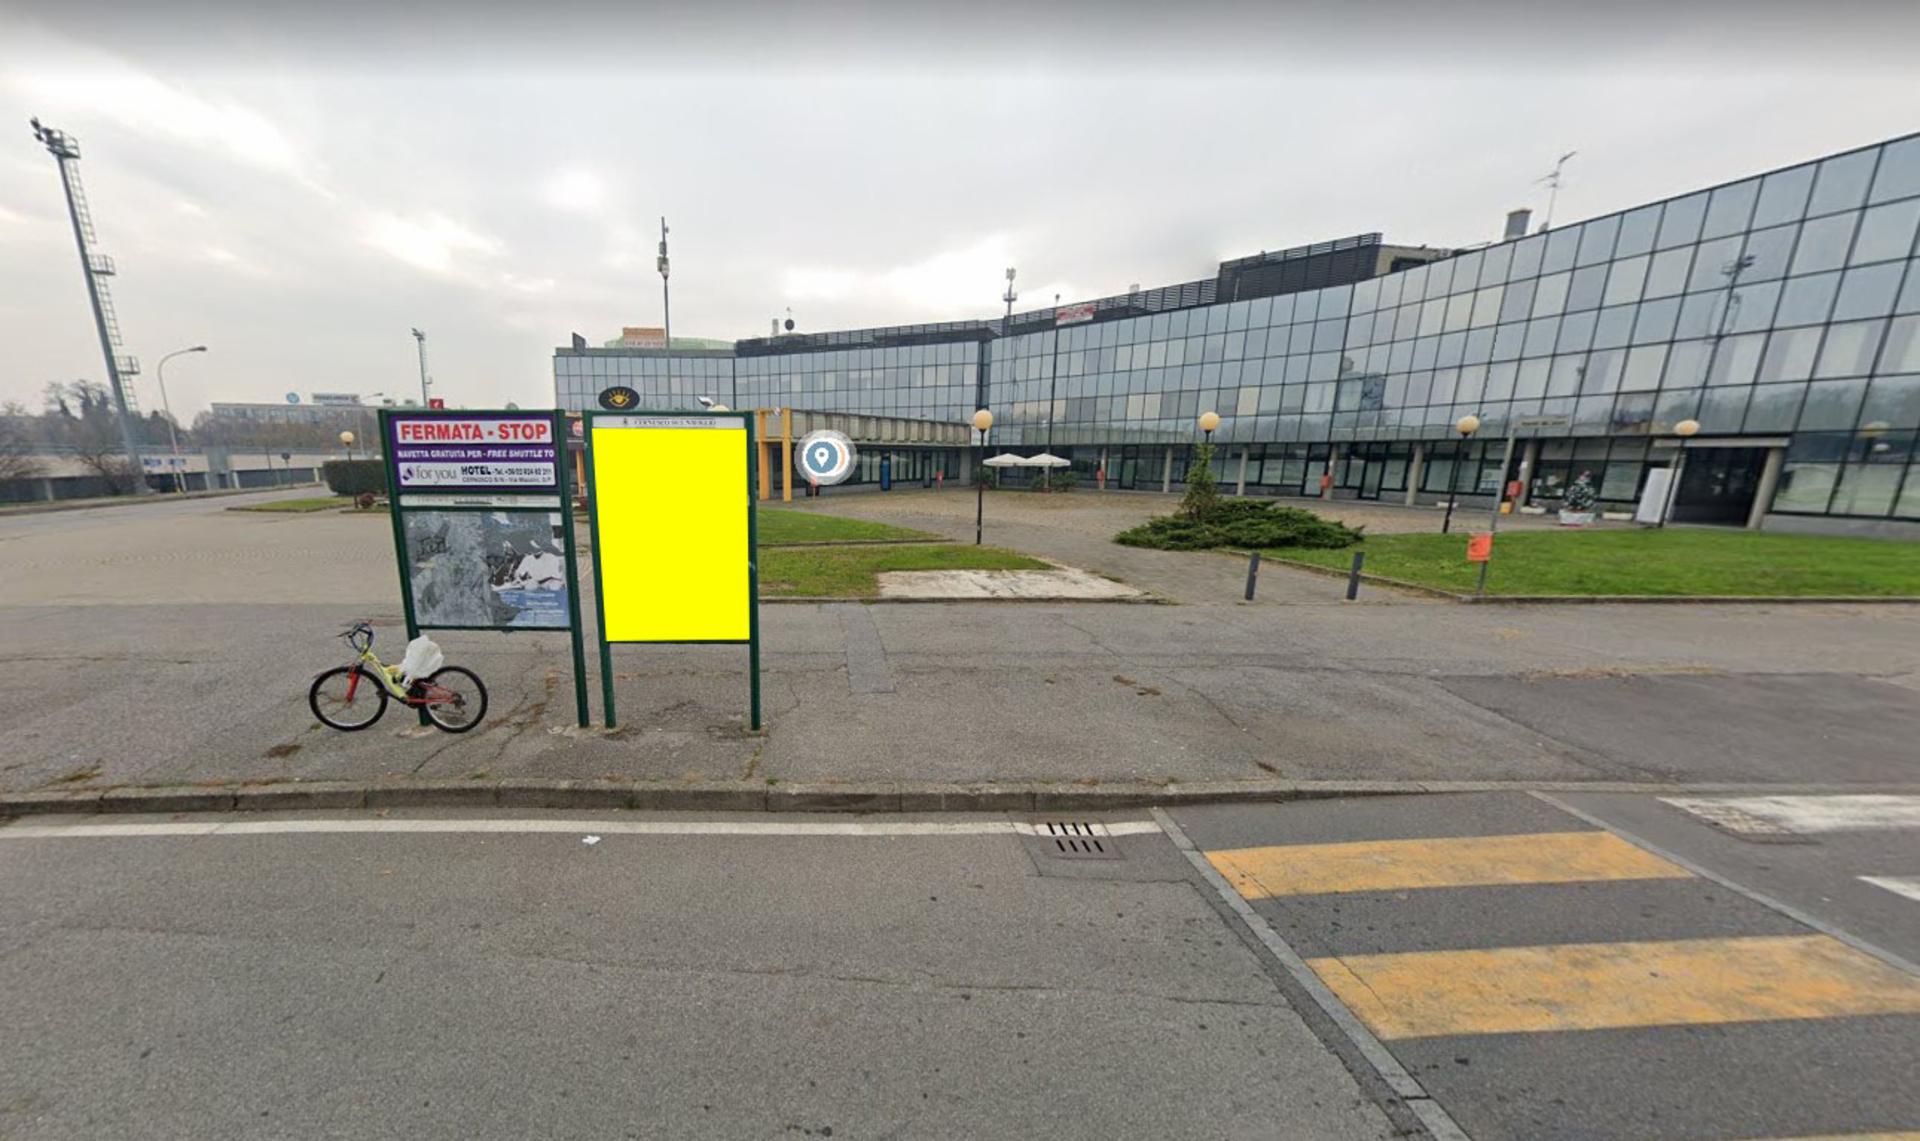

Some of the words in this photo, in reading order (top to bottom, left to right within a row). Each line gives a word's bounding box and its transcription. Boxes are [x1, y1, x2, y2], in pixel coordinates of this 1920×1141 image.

[401, 424, 483, 440] FERMATA
[498, 423, 547, 440] STOP
[398, 450, 429, 458] NAVETTA
[431, 450, 465, 458] GRATUITA
[467, 450, 482, 458] PER
[487, 449, 508, 458] FREE
[509, 449, 543, 458] SHUTTLE
[544, 449, 555, 458] TO
[461, 466, 491, 475] HOTEL
